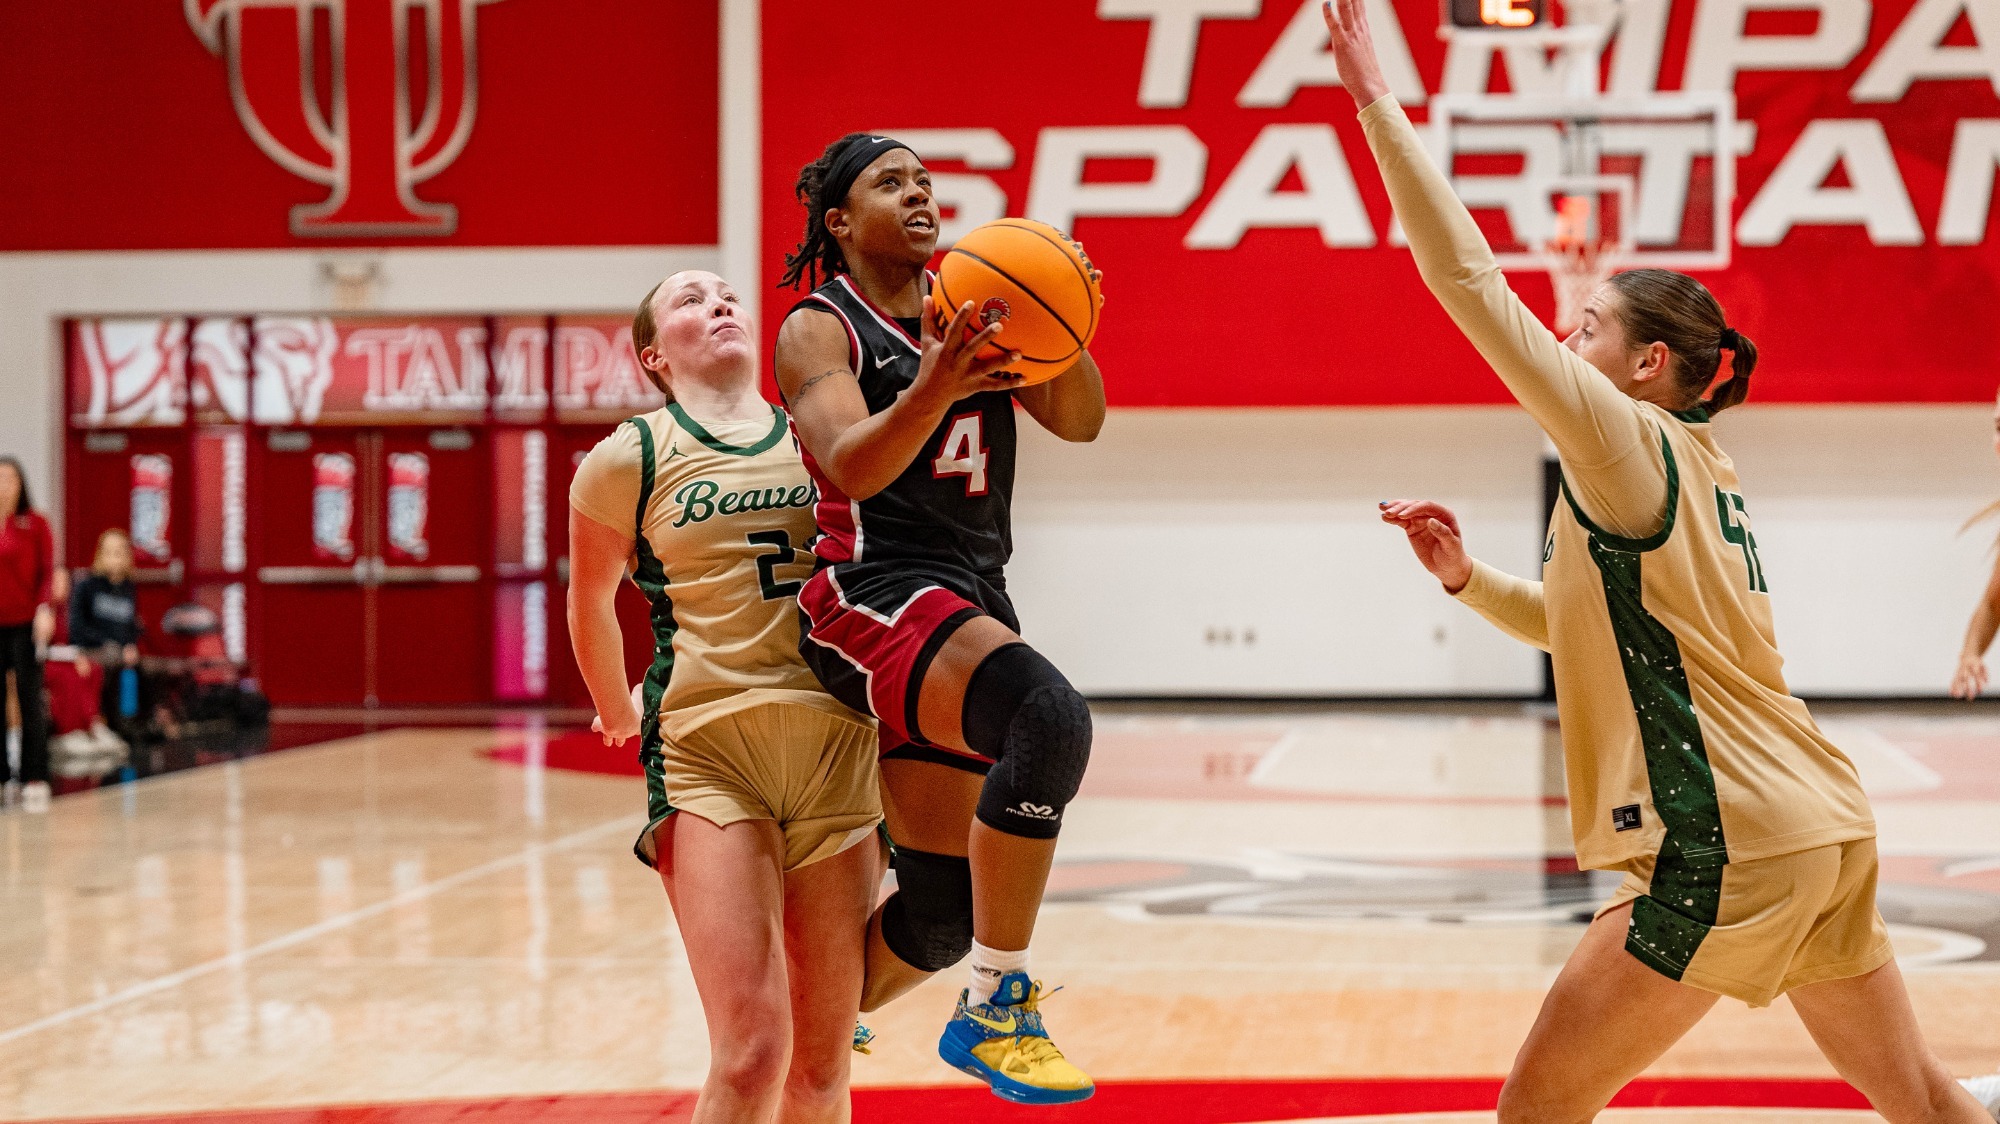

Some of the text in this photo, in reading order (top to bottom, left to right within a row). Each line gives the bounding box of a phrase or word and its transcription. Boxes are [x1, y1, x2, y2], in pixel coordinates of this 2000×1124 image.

[345, 325, 667, 411] TAMPA
[931, 411, 990, 497] 4
[672, 479, 816, 529] Beave
[1624, 812, 1637, 823] XL
